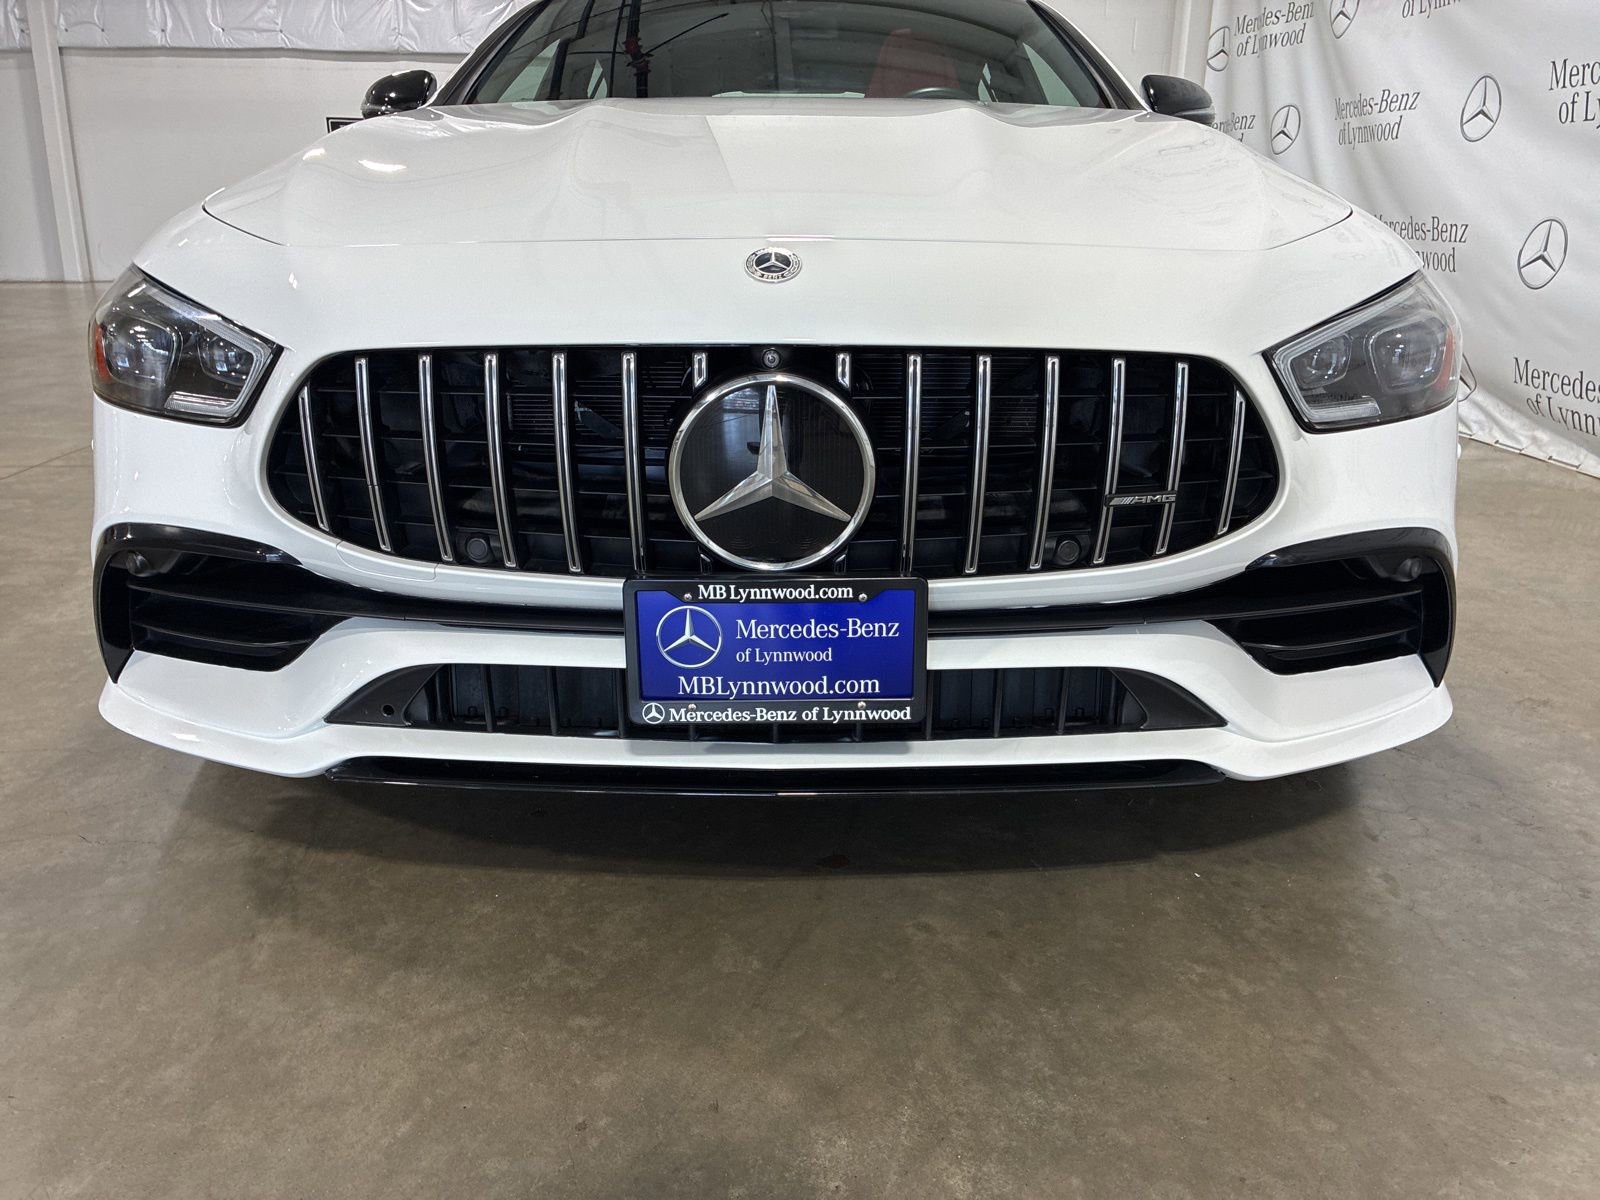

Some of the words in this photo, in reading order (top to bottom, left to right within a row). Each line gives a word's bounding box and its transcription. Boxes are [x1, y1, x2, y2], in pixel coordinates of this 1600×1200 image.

[1236, 35, 1251, 57] of
[1334, 88, 1421, 121] Mercedes-Benz
[1558, 91, 1579, 125] of
[1347, 114, 1403, 150] Lynnwood
[1526, 393, 1546, 417] of
[1546, 395, 1600, 437] Lynn
[735, 618, 900, 640] Mercedes-Benz
[736, 648, 752, 663] of
[755, 647, 833, 664] Lynnwood
[678, 675, 881, 700] MBLynnwood.com
[669, 706, 797, 723] Mercedes-Benz
[802, 706, 817, 721] of
[822, 706, 912, 724] Lynnwood
